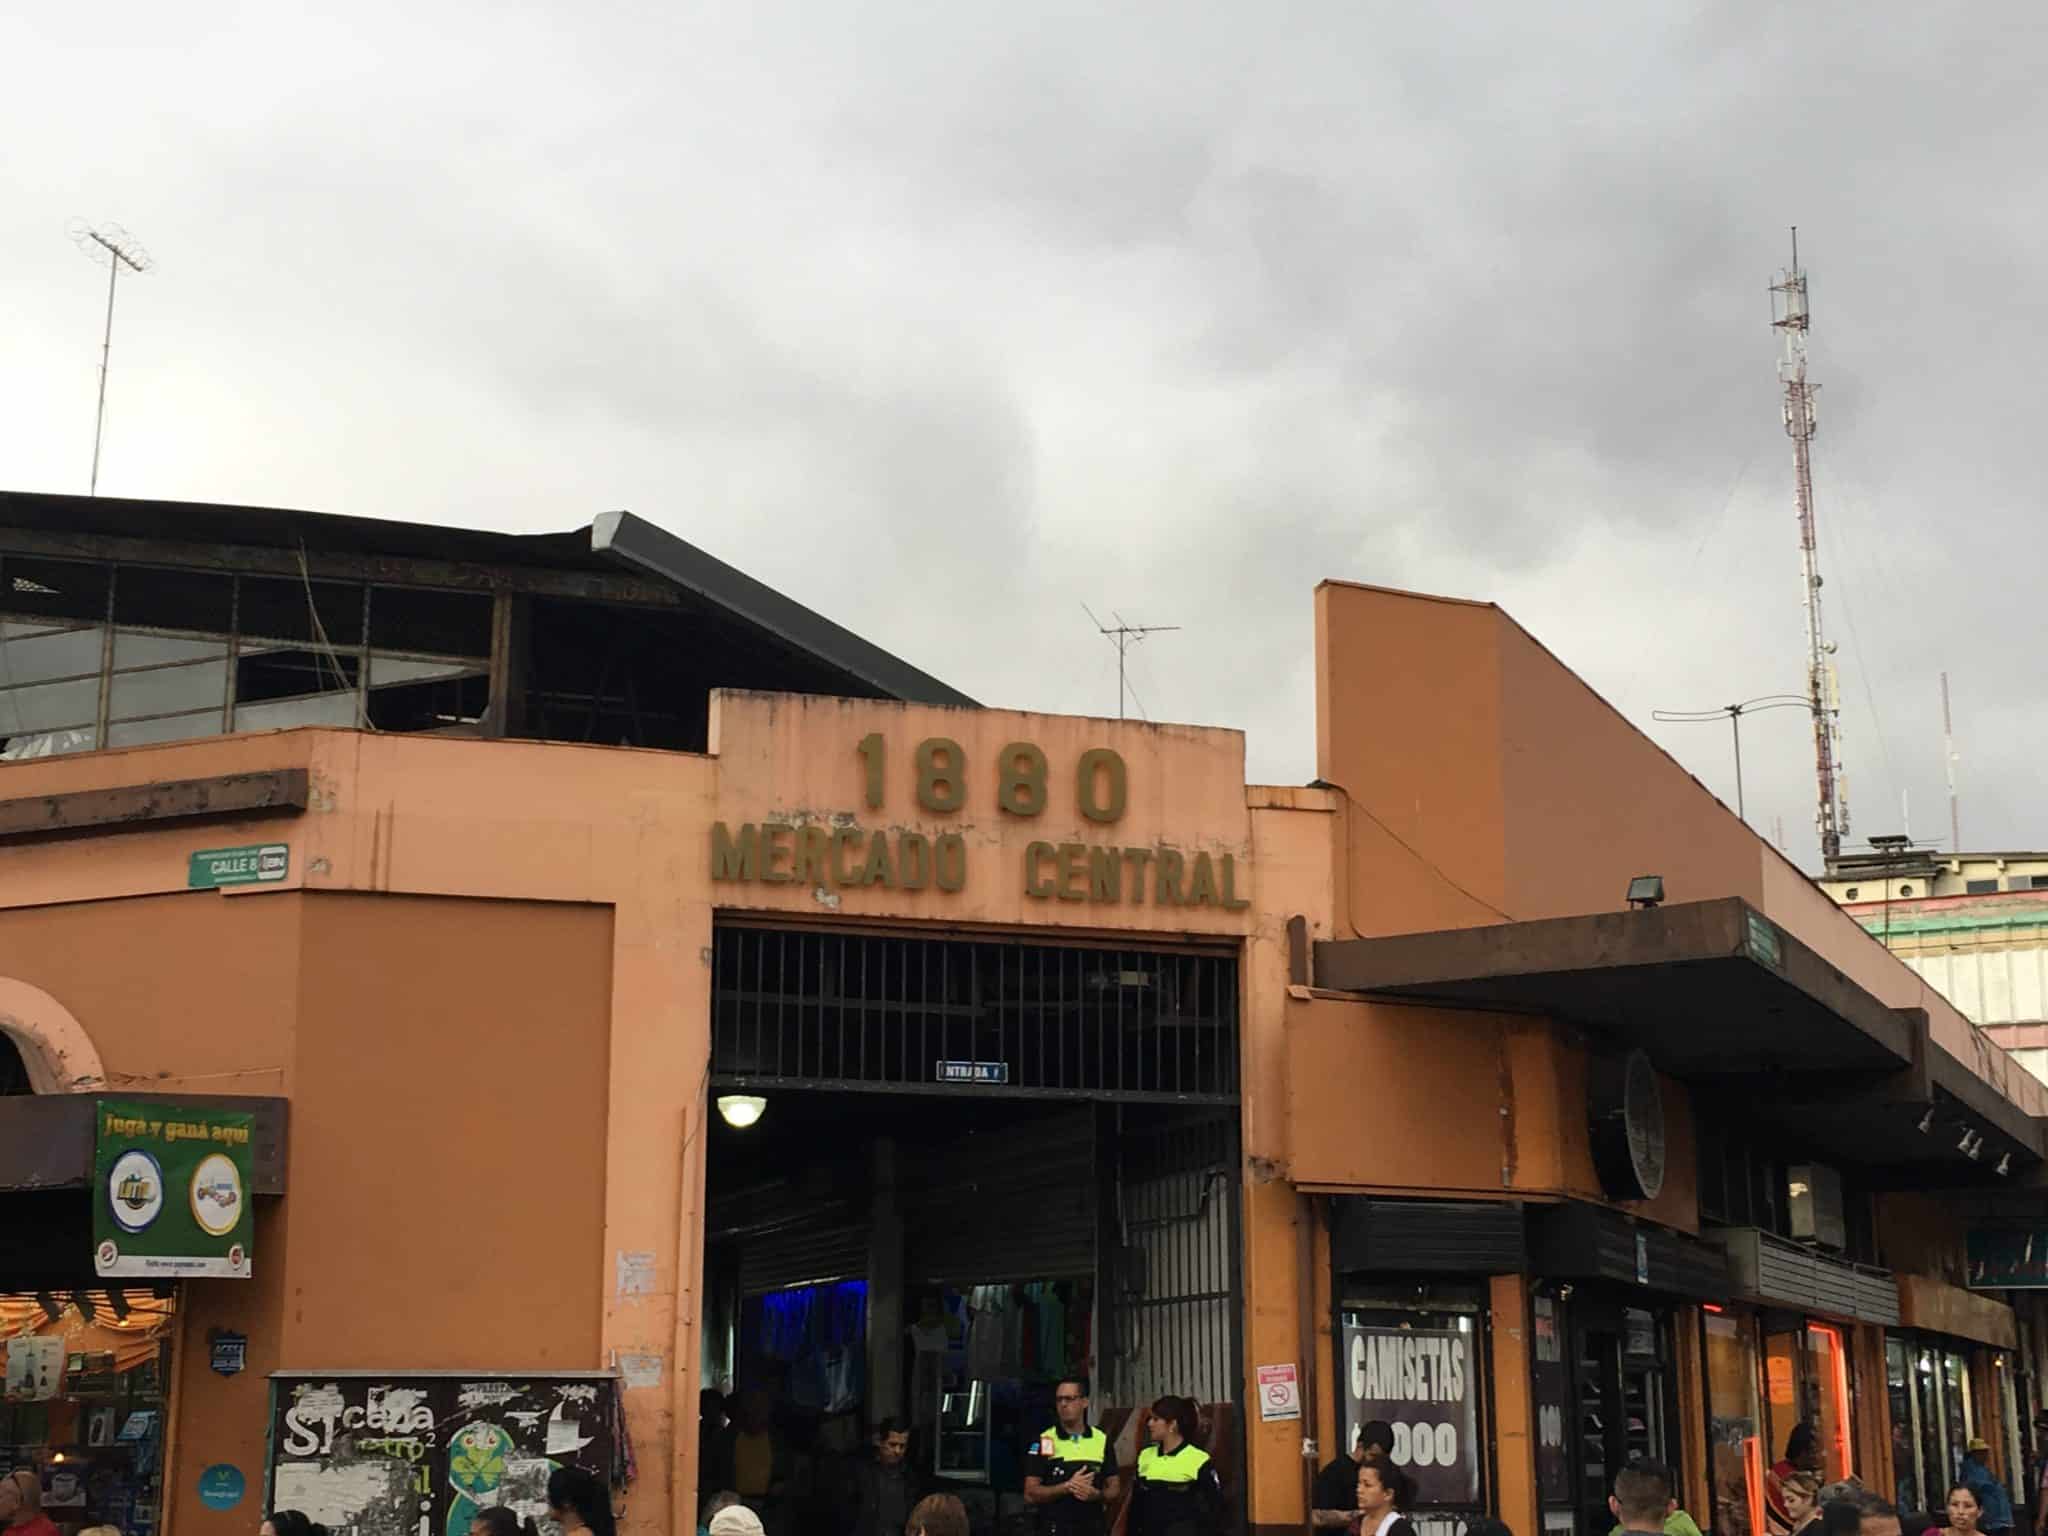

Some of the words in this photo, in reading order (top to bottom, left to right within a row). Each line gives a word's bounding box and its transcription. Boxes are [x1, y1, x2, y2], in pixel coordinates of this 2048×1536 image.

[857, 732, 1128, 824] 1880
[210, 859, 247, 874] CALLE
[711, 821, 967, 893] MERCADO
[1024, 840, 1250, 909] CENTRAL
[1351, 1335, 1464, 1401] CAMISETAS
